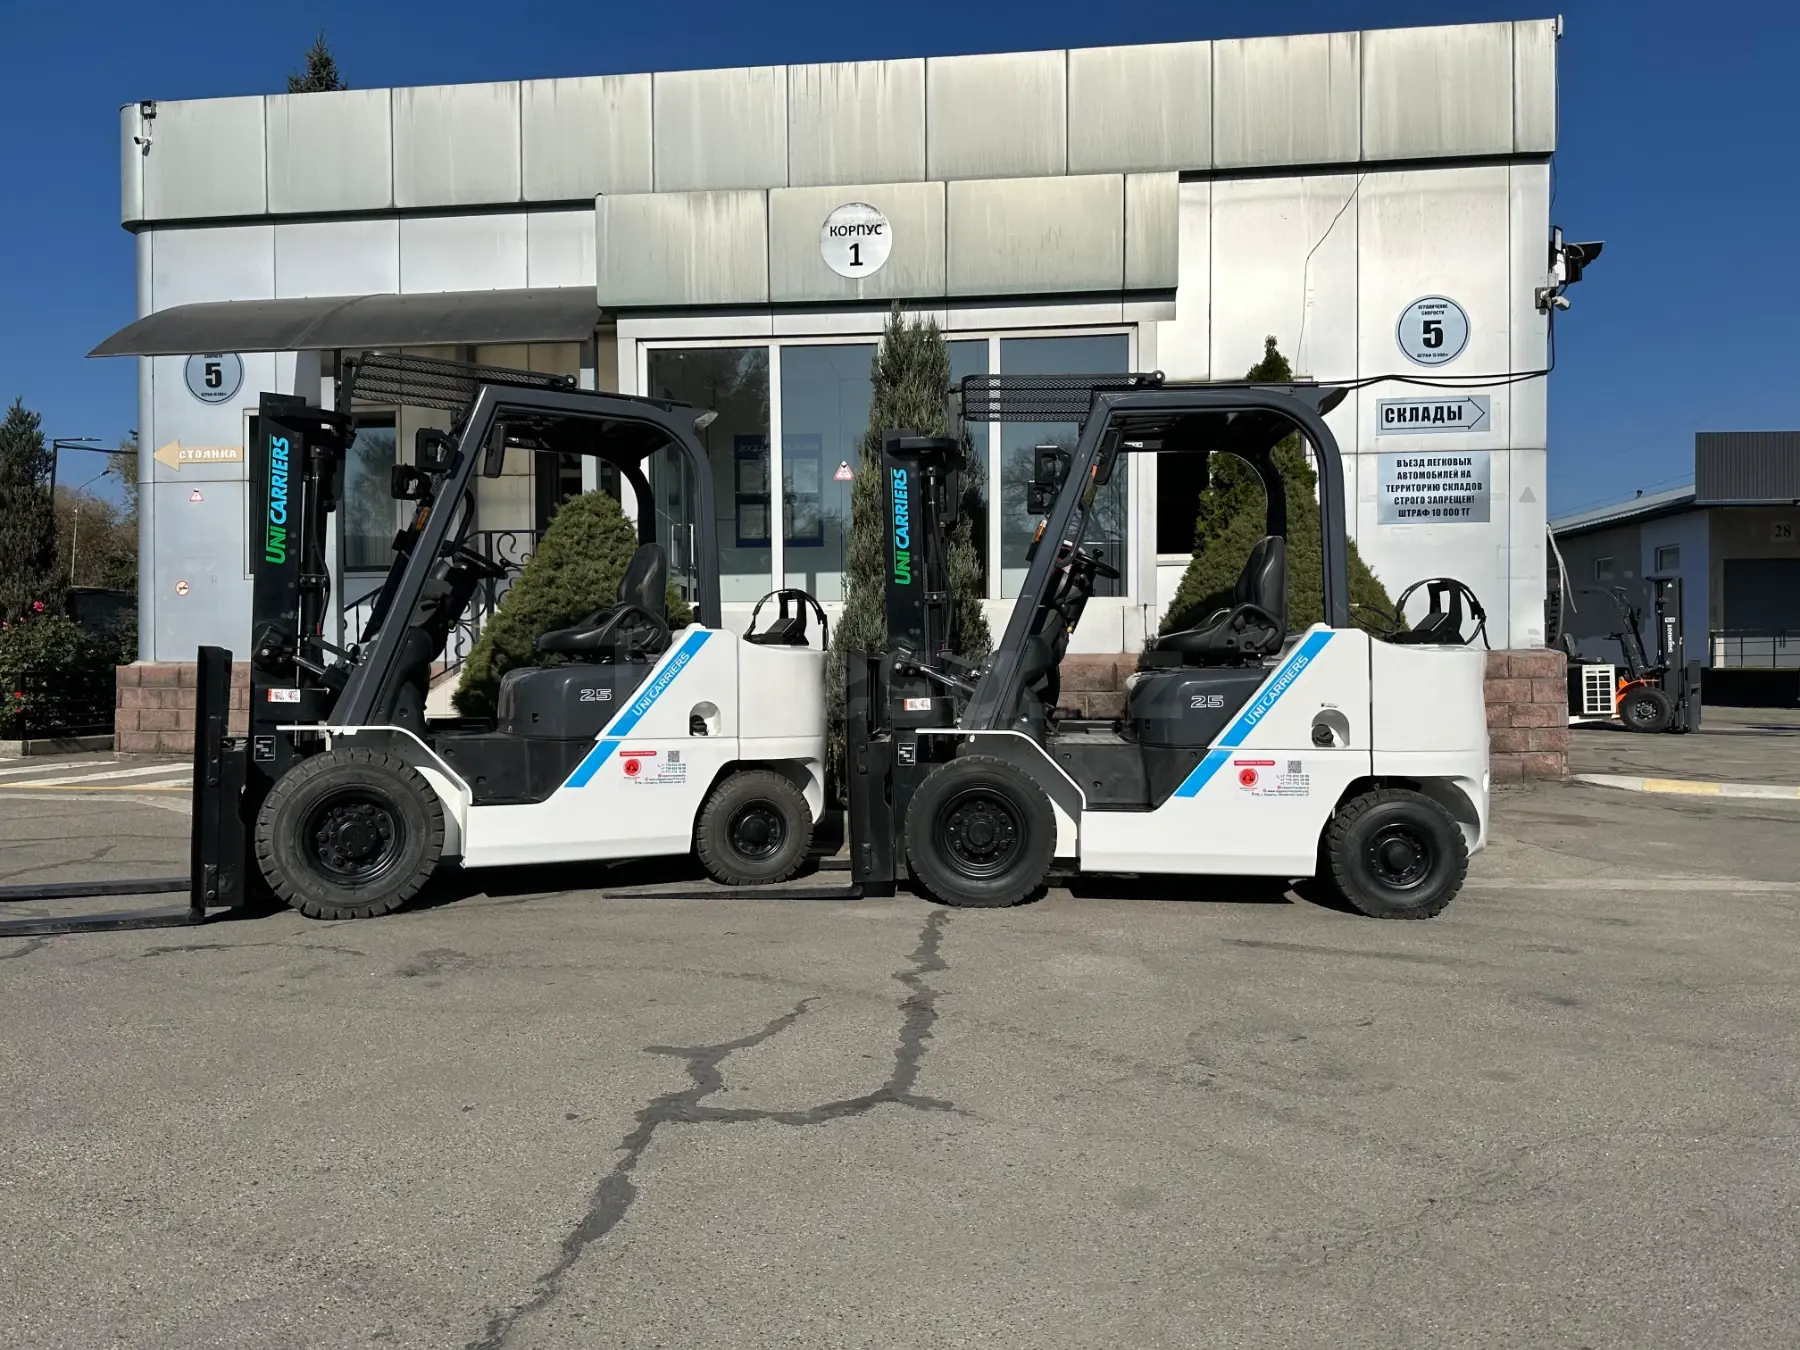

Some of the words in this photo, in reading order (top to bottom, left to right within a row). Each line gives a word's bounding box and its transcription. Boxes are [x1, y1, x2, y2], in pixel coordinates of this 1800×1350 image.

[829, 223, 883, 237] КОРПУС
[849, 242, 864, 266] 1
[1422, 319, 1444, 349] 5
[205, 362, 223, 388] 5
[1384, 404, 1463, 424] СКЛАДЫ
[178, 449, 237, 459] СТОЯНКА
[1396, 459, 1425, 468] ВЪЕЗД
[1426, 457, 1472, 466] ЛЕГКОВЫХ
[1397, 469, 1458, 480] АВТОМОБИЛЕЙ
[1460, 470, 1472, 478] НА
[1386, 483, 1440, 492] ТЕРРИТОРИЮ
[1442, 482, 1482, 492] СКЛАДОВ
[1394, 496, 1425, 505] СТРОГО
[1427, 495, 1475, 504] ЗАПРЕЩЕН!
[1398, 509, 1430, 517] ШТРАФ
[1432, 508, 1440, 517] 10
[1443, 508, 1459, 516] 000
[1461, 508, 1471, 516] ТГ
[1775, 525, 1792, 537] 28
[580, 688, 612, 702] 25
[1190, 695, 1224, 708] 25
